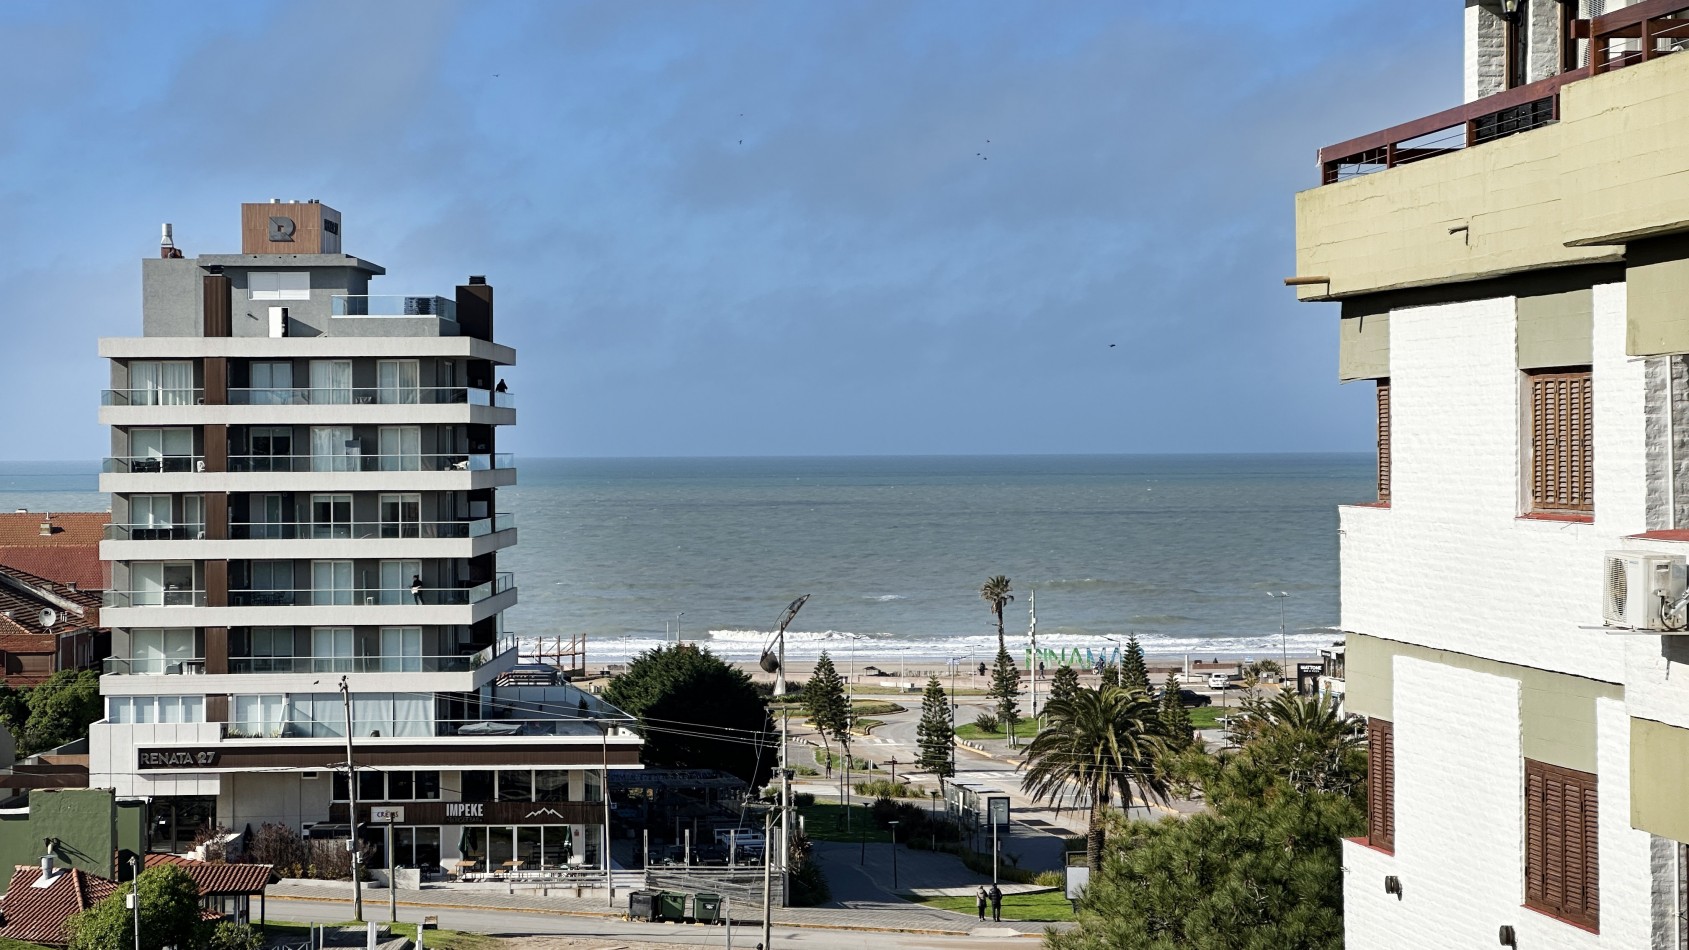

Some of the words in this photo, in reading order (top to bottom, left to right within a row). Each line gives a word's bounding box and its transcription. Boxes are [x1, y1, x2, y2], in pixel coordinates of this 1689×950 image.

[140, 752, 194, 765] RENATA
[197, 751, 215, 764] 27
[446, 803, 484, 817] IMPEKE
